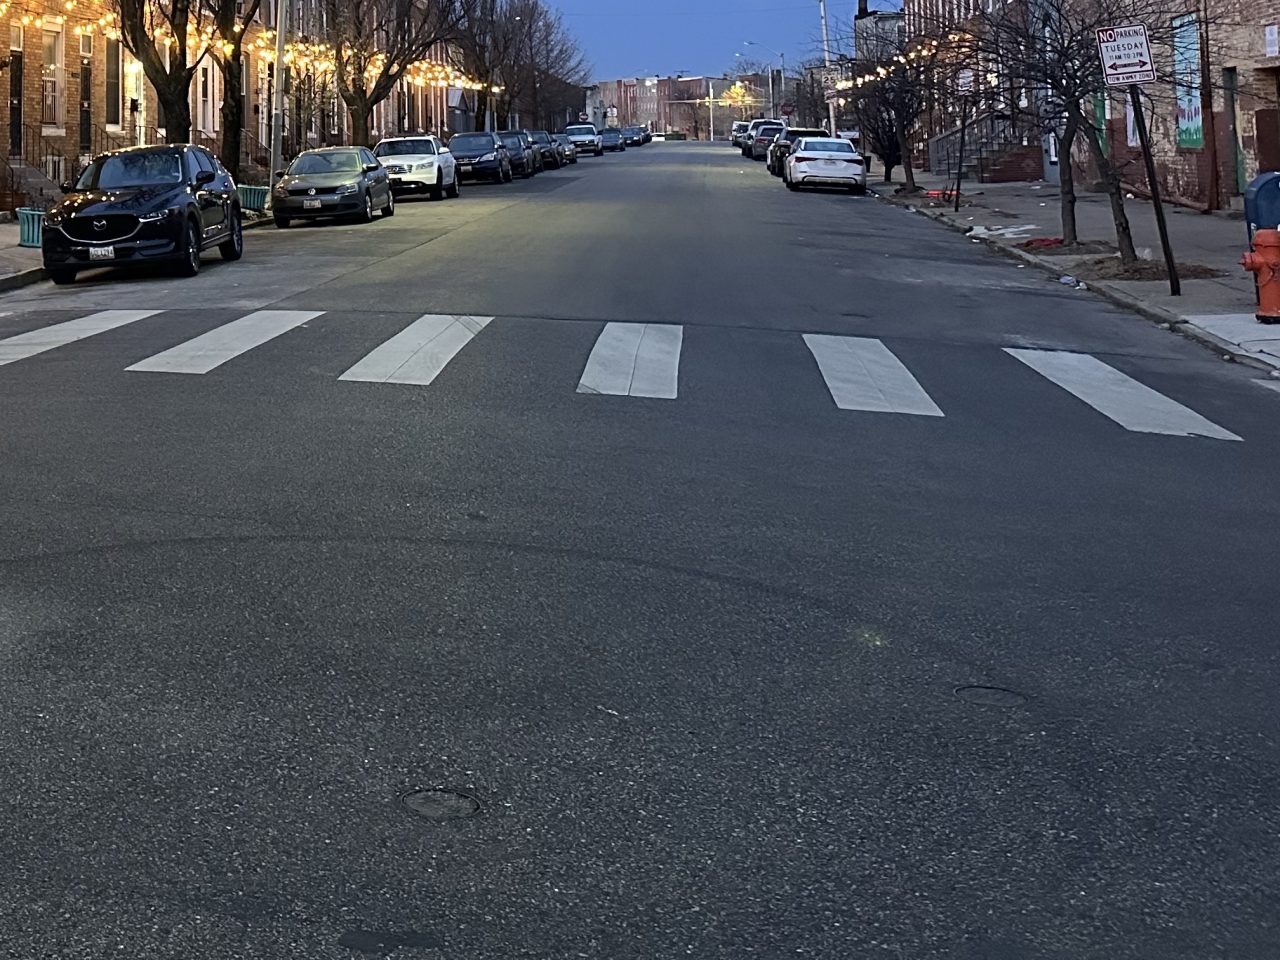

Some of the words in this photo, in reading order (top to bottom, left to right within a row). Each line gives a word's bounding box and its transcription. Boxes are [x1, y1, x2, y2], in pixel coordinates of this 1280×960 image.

[1099, 30, 1115, 42] NO
[1116, 28, 1144, 38] PARKING
[1104, 42, 1143, 52] TUESDAY
[824, 76, 835, 84] 25
